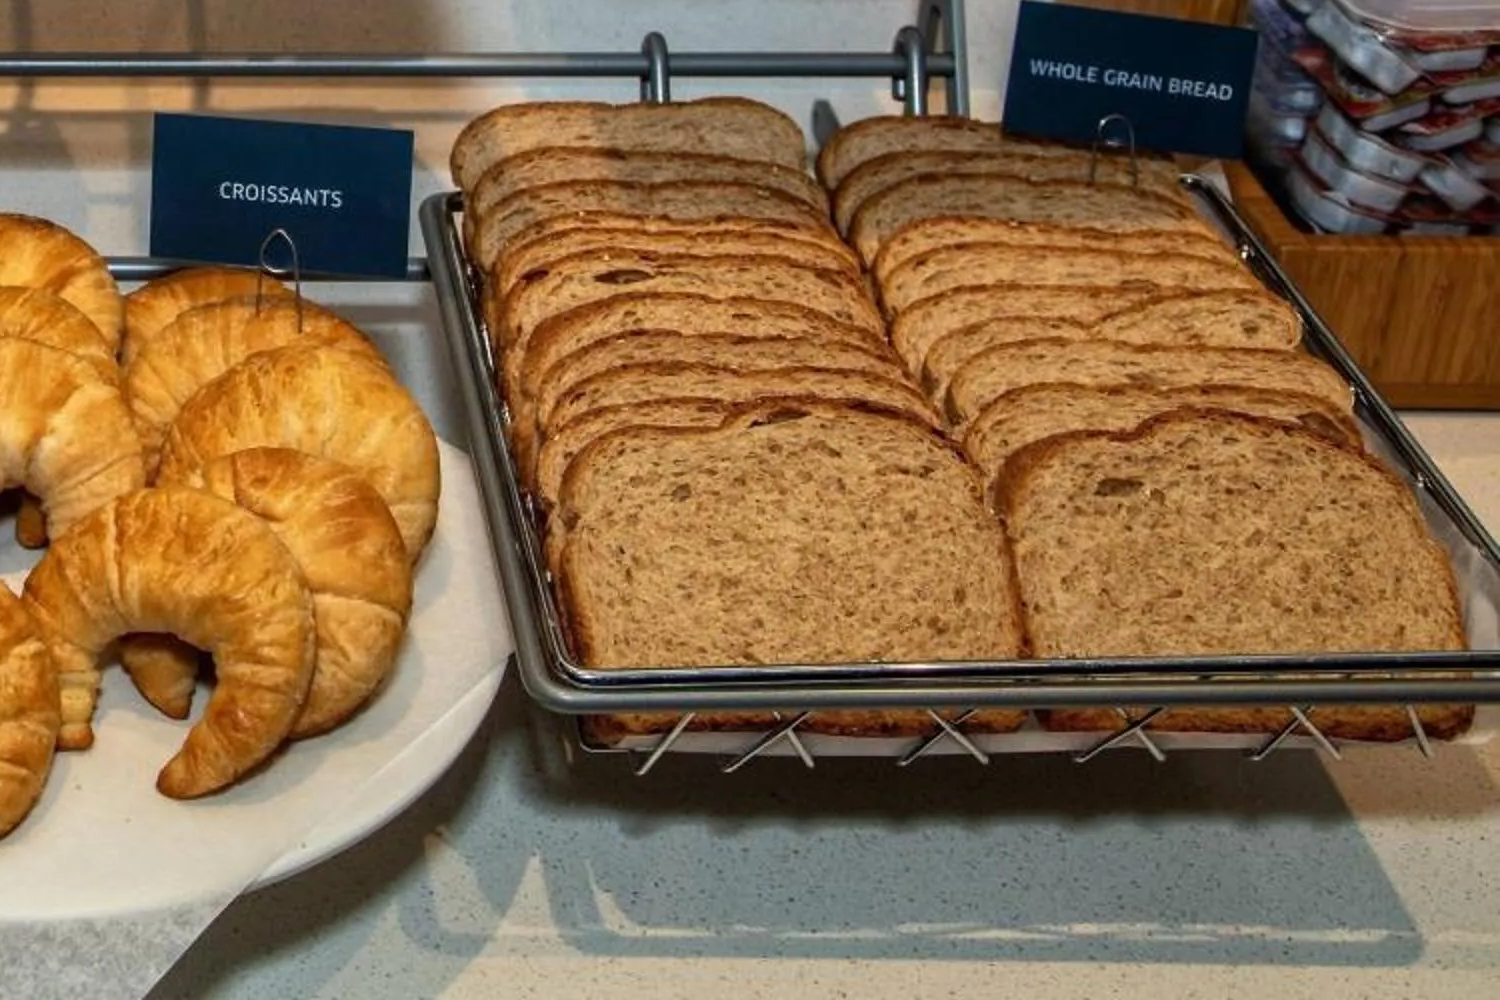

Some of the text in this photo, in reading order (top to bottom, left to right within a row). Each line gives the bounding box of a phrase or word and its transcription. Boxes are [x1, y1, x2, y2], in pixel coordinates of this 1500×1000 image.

[1031, 60, 1232, 100] WHOLE GRAIN BREAD
[220, 182, 342, 208] CROISSANTS
